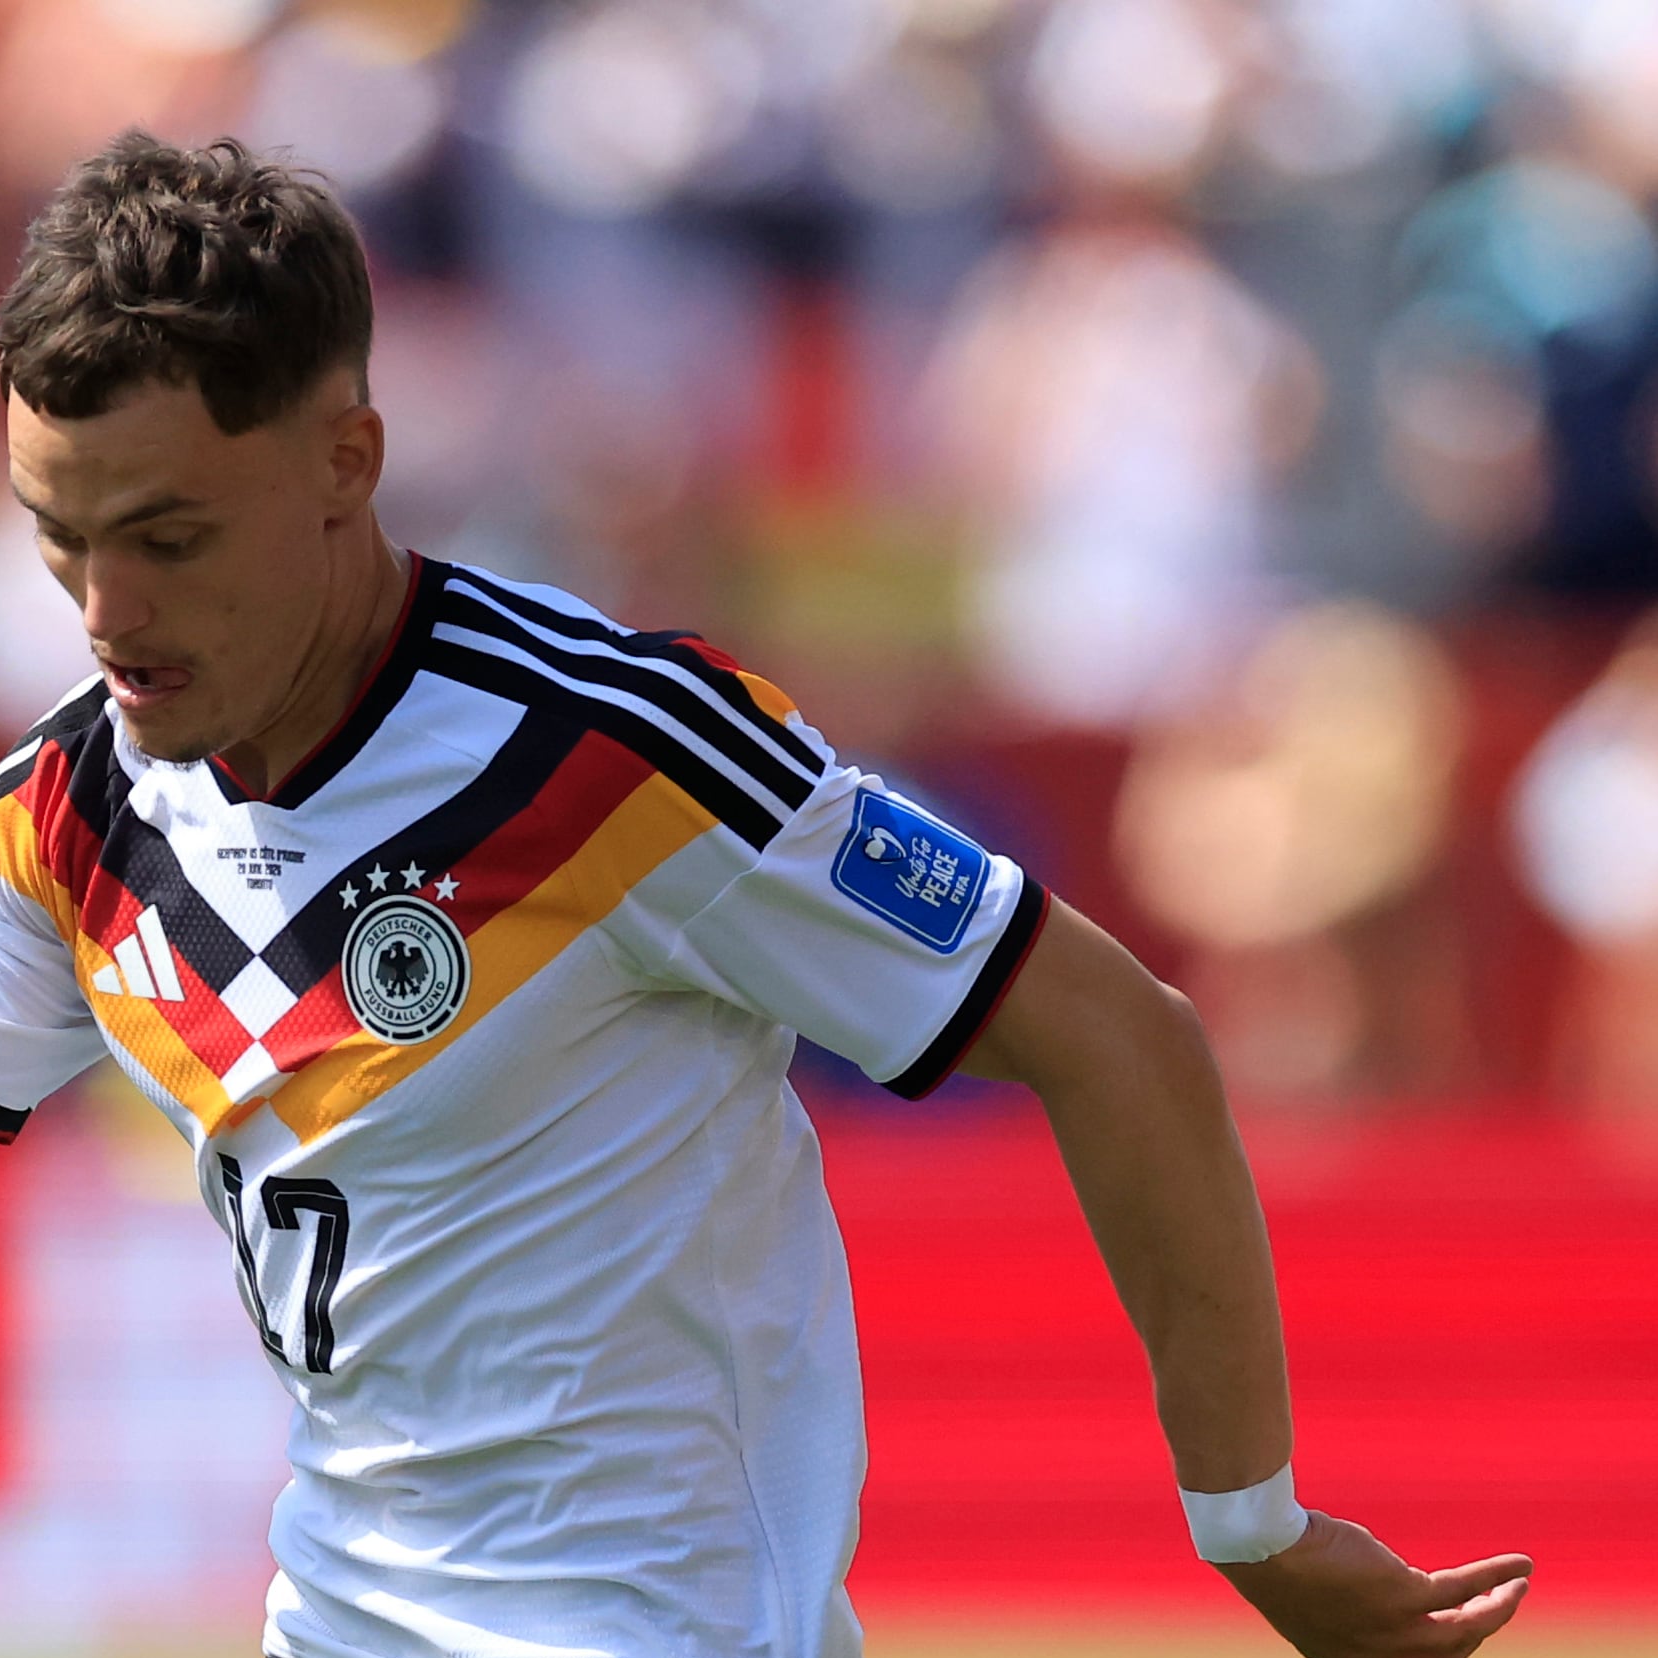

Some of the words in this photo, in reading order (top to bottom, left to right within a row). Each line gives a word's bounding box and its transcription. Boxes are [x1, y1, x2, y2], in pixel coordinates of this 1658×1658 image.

[919, 849, 959, 908] PEACE
[950, 875, 971, 905] FIFA
[366, 919, 433, 947] DEUTSCHER
[217, 1152, 349, 1375] 17
